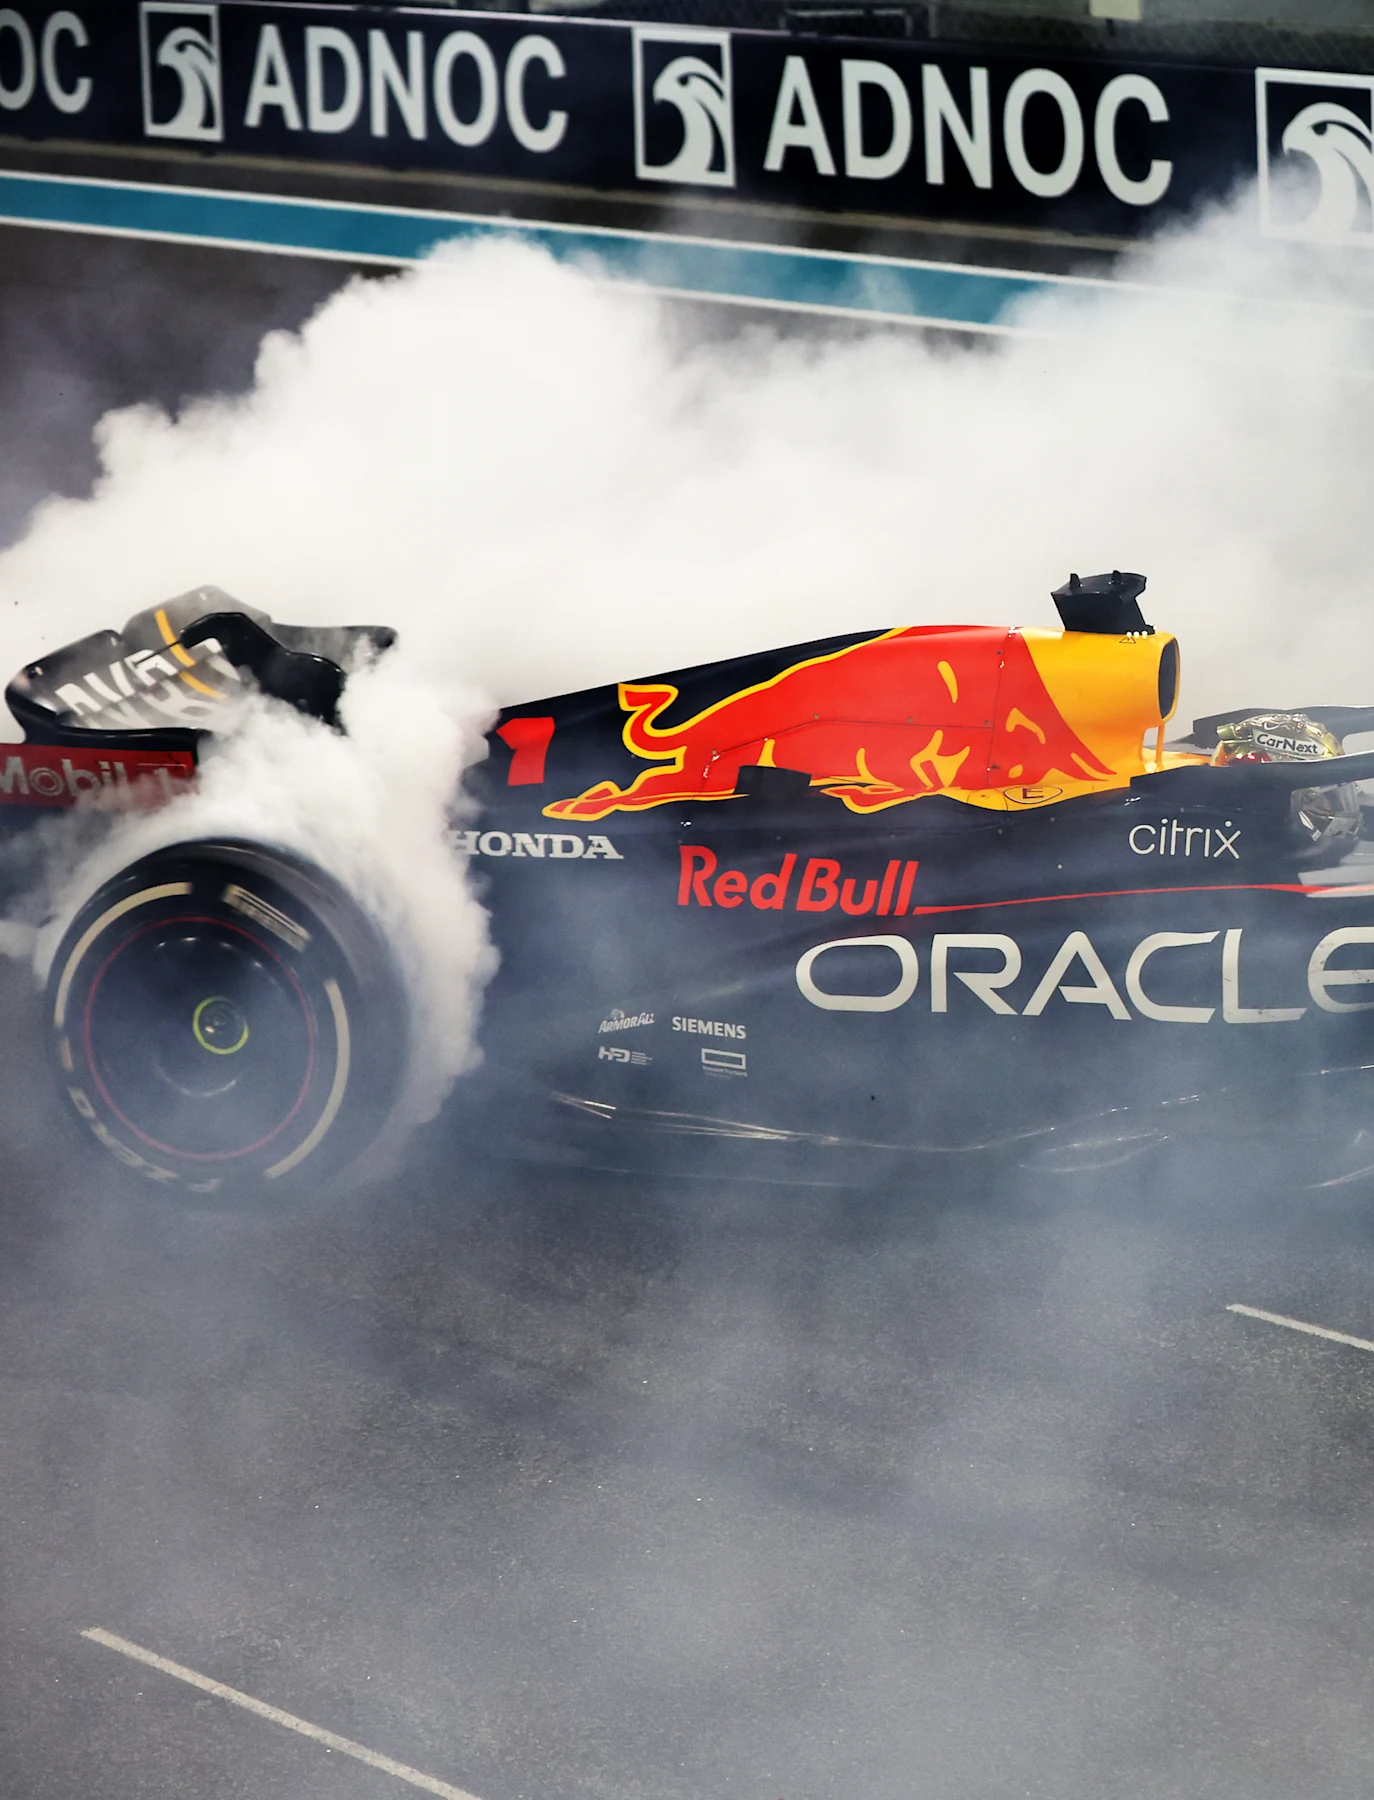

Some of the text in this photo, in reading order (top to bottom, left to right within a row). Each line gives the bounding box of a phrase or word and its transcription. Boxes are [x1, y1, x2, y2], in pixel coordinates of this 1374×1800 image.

[244, 24, 568, 153] ADNOC
[764, 55, 1173, 205] ADNOC
[495, 717, 555, 787] 1
[1256, 733, 1319, 754] CarNext
[446, 830, 625, 860] HONDA
[1128, 819, 1242, 860] citrix
[677, 845, 919, 916] Red Bull
[671, 1016, 746, 1040] SIEMENS
